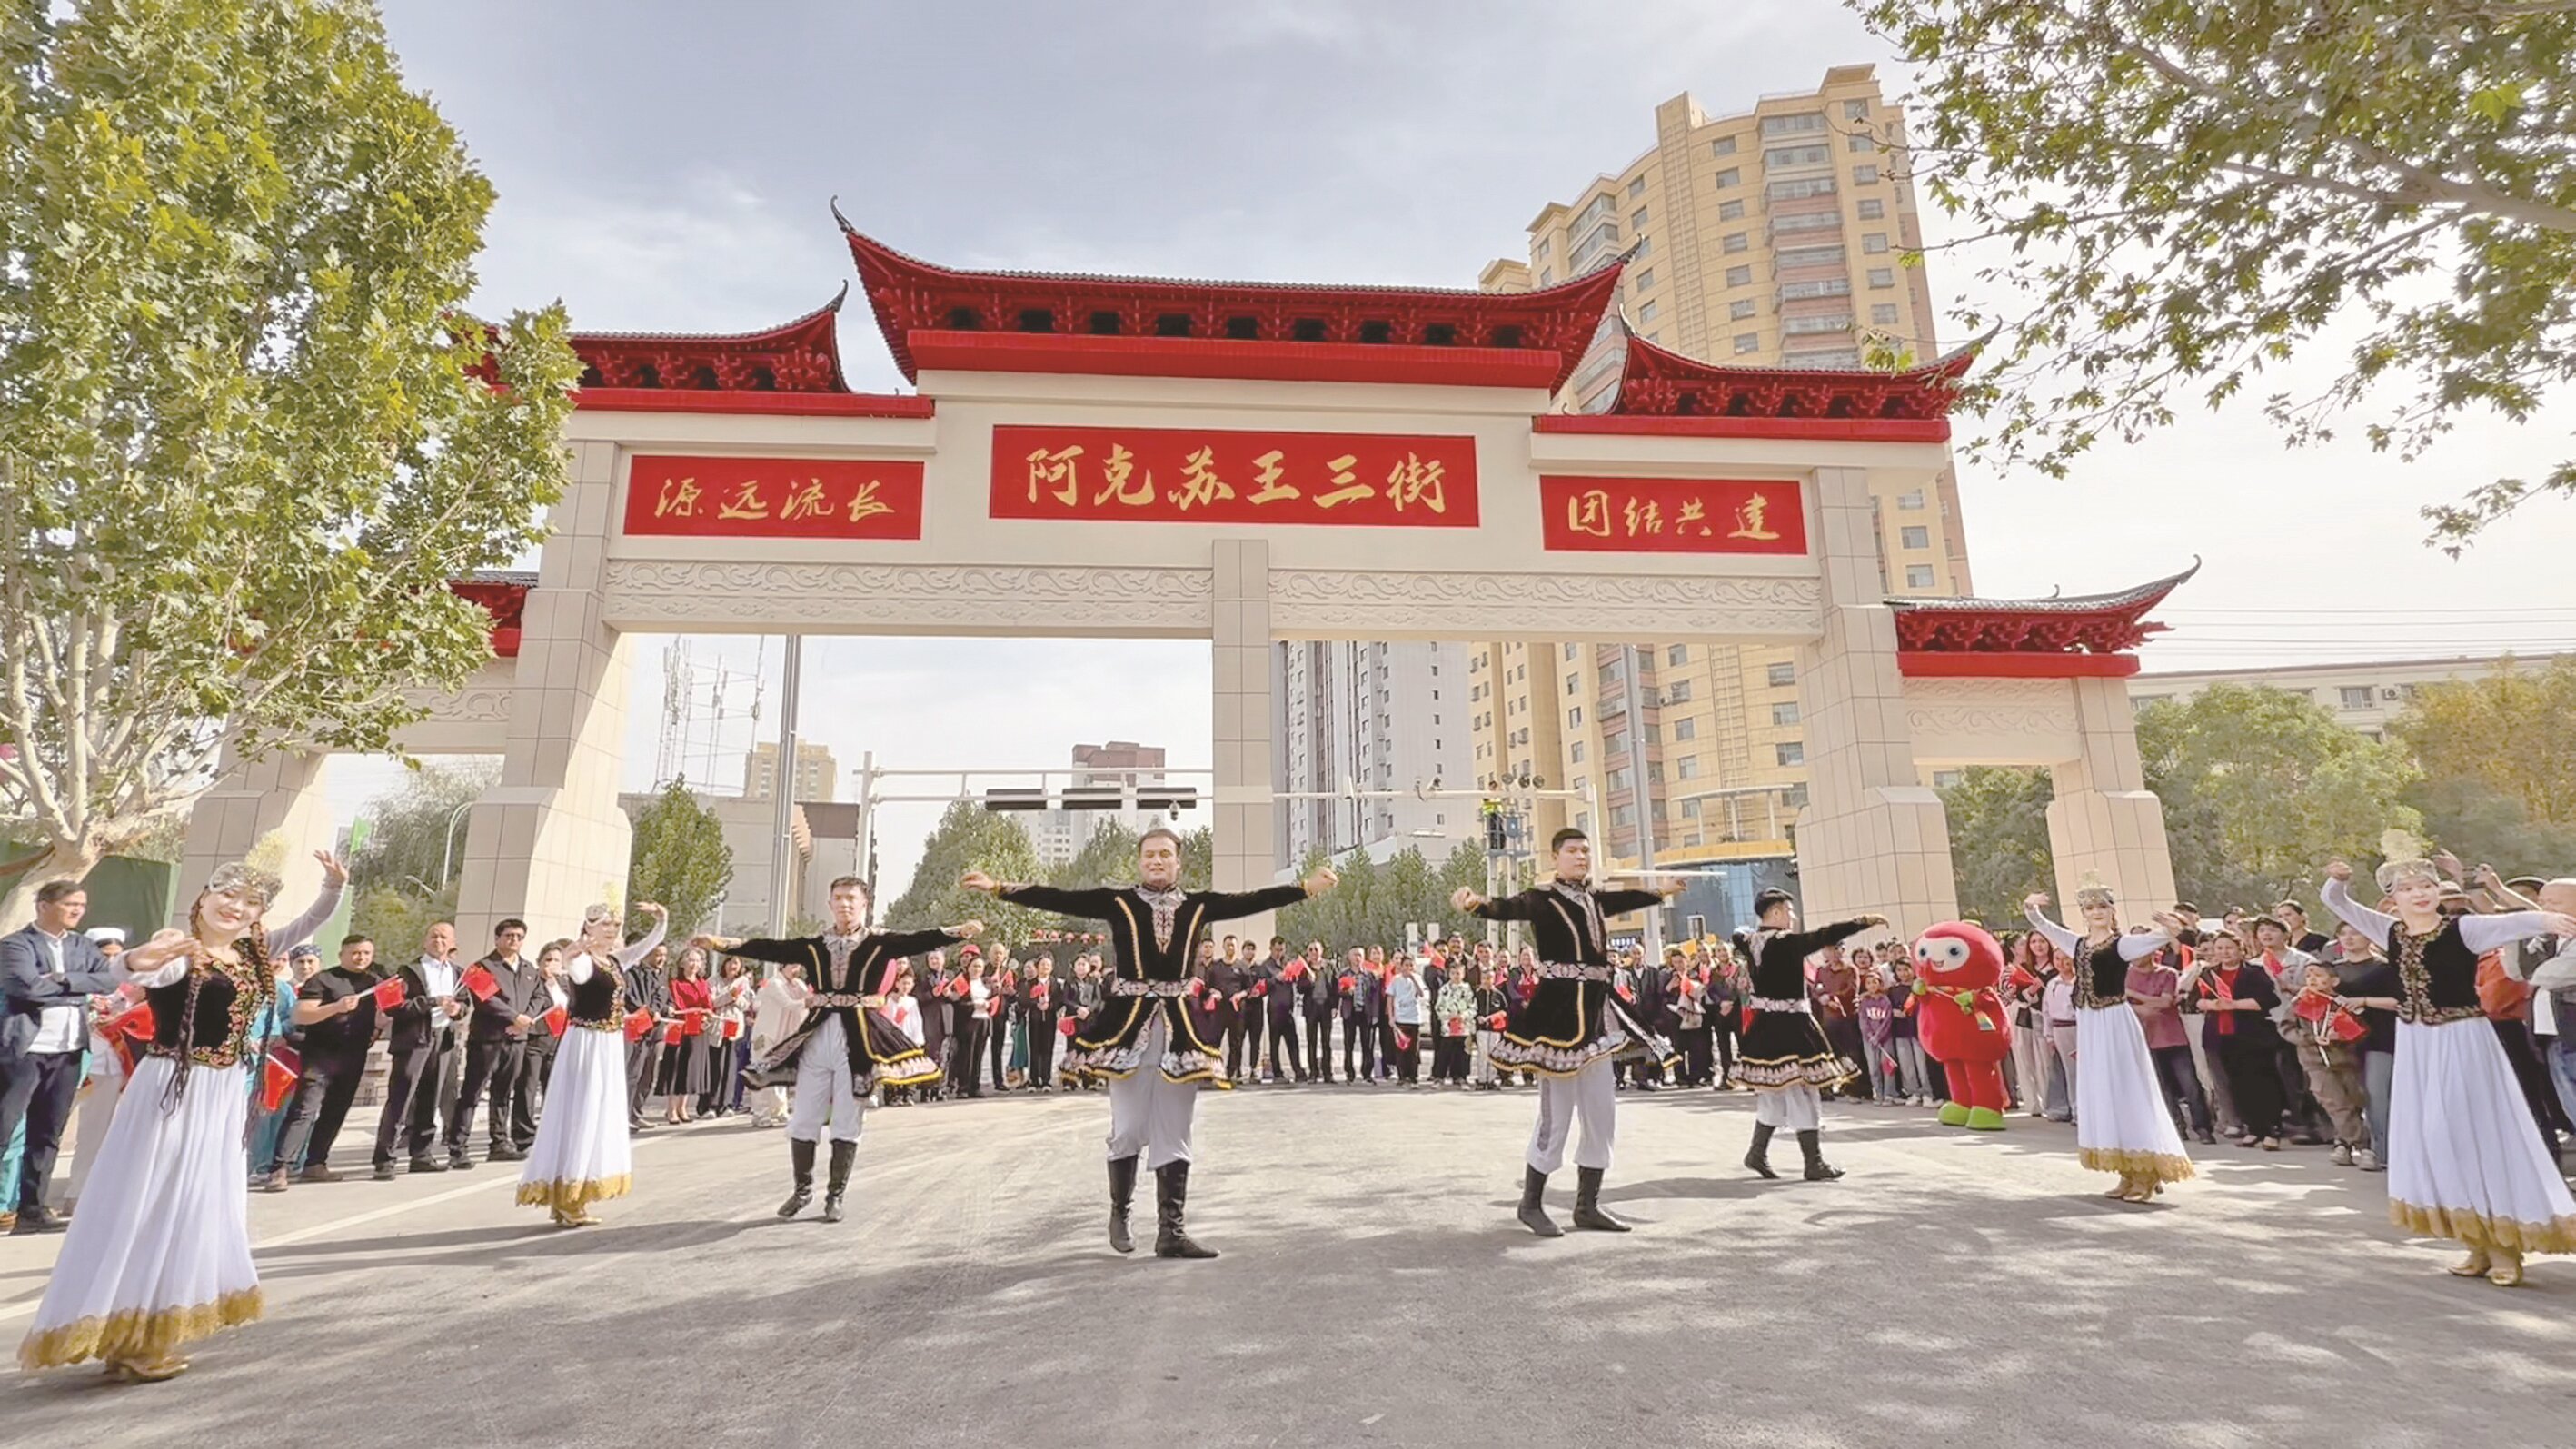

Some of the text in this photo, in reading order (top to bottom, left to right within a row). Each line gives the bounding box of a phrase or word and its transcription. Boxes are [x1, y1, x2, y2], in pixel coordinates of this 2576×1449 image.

[654, 477, 895, 522] 源远流长
[1026, 443, 1446, 515] 阿克苏王三街
[1567, 490, 1780, 541] 团结共建
